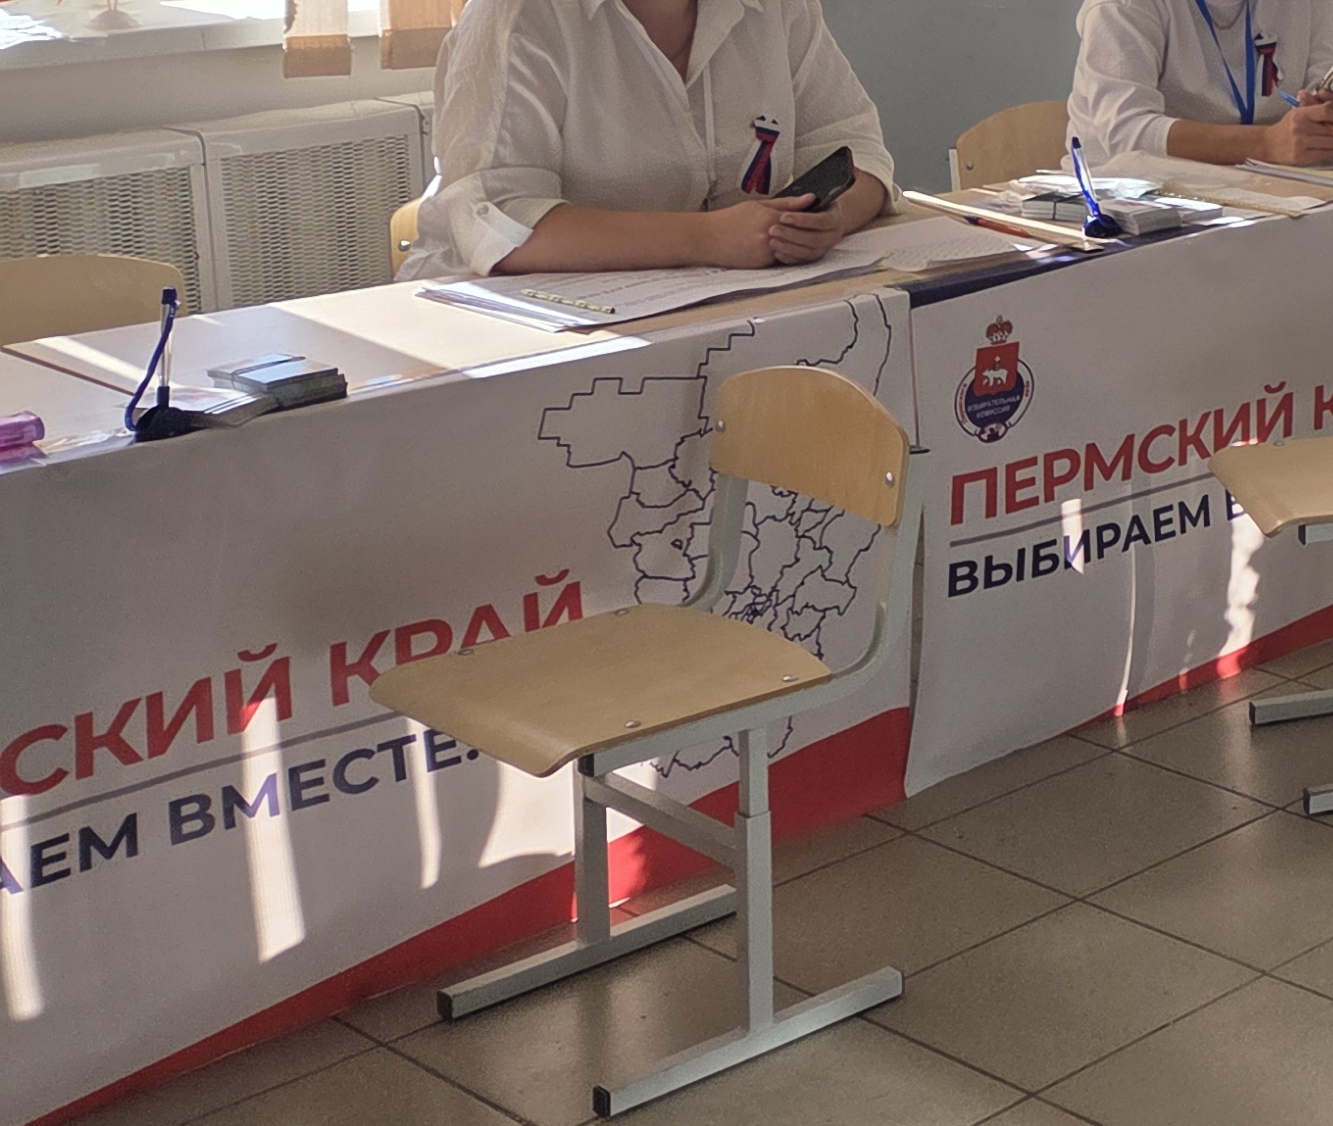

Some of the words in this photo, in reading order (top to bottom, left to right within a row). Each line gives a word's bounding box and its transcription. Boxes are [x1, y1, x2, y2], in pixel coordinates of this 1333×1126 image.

[951, 381, 1294, 526] ПЕРМСКИЙ
[948, 494, 1211, 598] ВЫБИРАЕМ
[0, 643, 292, 796] СКИЙ
[330, 569, 583, 707] КРАЙ
[168, 729, 479, 845] ВМЕСТЕ.
